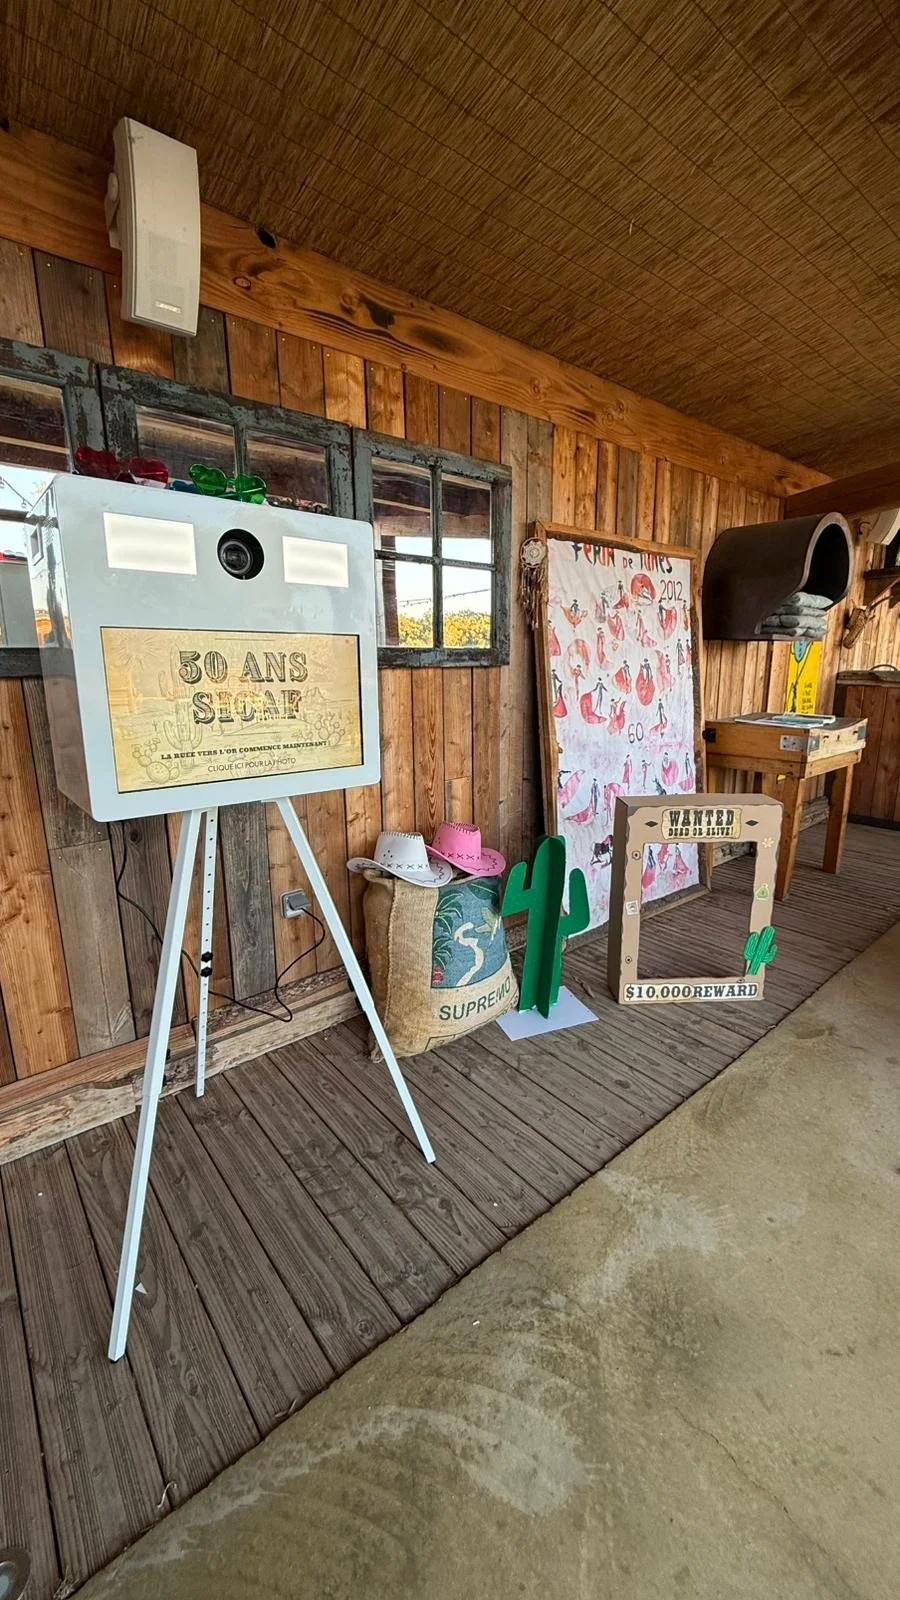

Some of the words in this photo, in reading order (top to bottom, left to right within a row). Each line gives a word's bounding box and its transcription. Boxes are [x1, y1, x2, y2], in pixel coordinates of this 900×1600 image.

[659, 579, 684, 603] 2012
[178, 650, 229, 685] 50
[240, 651, 309, 683] ANS
[627, 721, 645, 744] 60
[197, 749, 218, 758] VERS
[219, 747, 238, 756] L'OR
[238, 744, 282, 754] COMMENCE
[282, 740, 328, 751] MAINTENANT
[207, 764, 234, 773] CLIQUE
[234, 762, 244, 770] ICI
[244, 760, 264, 769] POUR
[264, 759, 272, 768] LA
[669, 809, 735, 828] WANTED
[668, 827, 690, 837] DEAD
[692, 827, 703, 837] OR
[706, 826, 735, 837] ALIVE!
[438, 975, 511, 1021] SUPREMO
